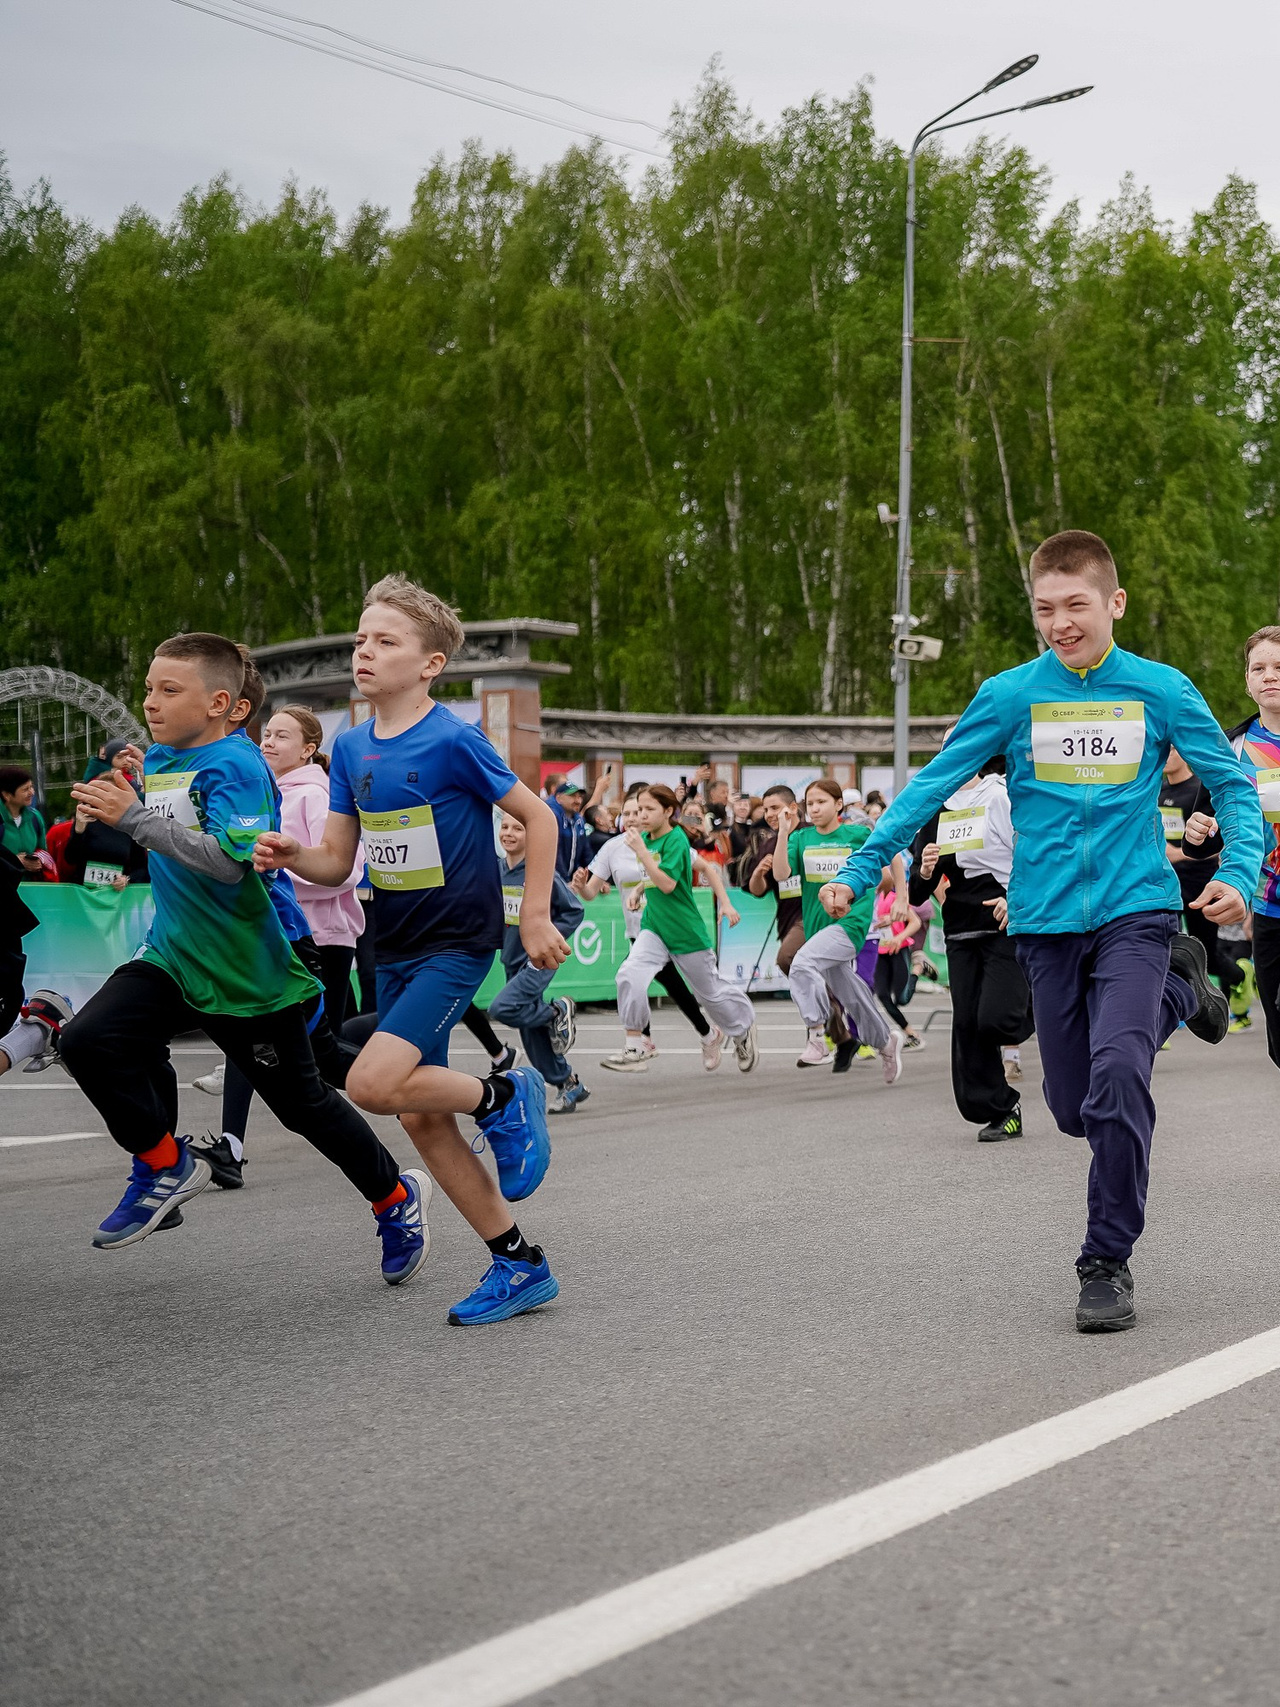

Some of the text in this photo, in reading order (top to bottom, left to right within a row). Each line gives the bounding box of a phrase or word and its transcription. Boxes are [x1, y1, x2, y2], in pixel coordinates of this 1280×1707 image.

[1061, 736, 1118, 757] 3184
[949, 826, 973, 840] 3212
[368, 844, 409, 865] 3207
[815, 863, 839, 872] 3200
